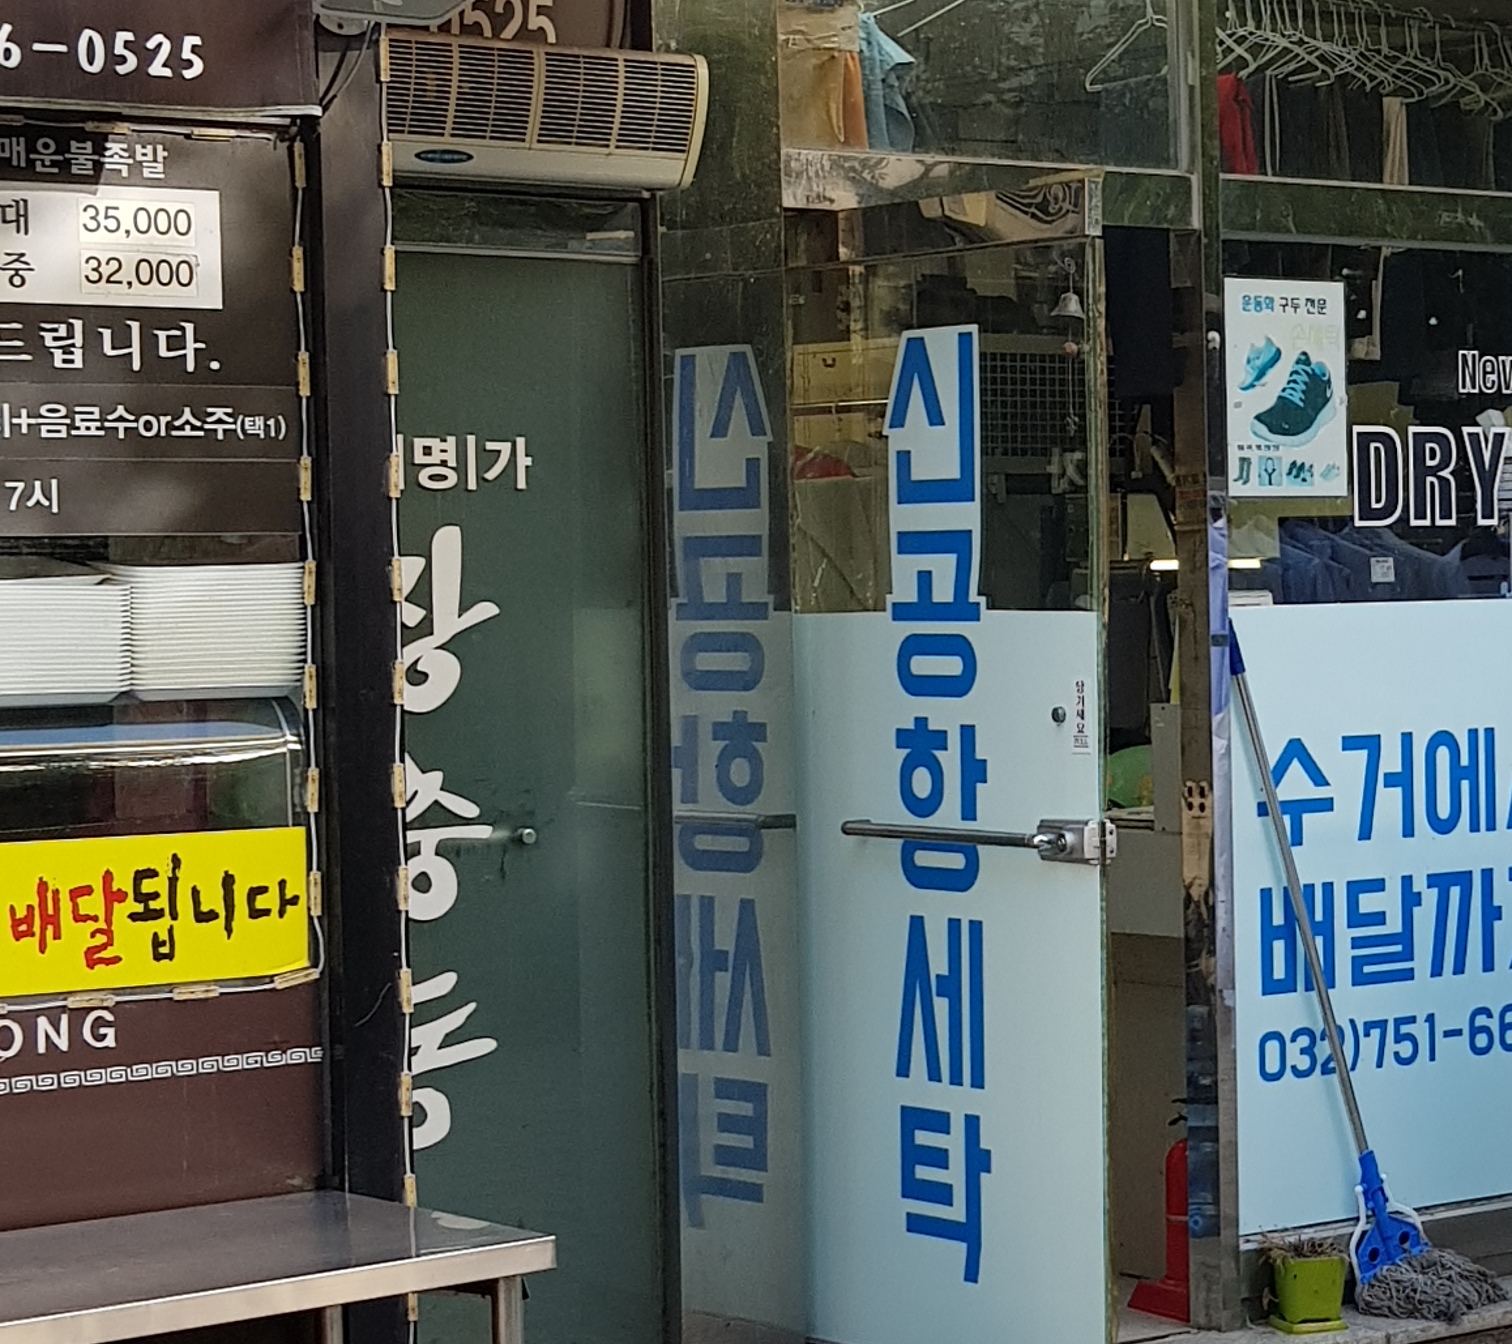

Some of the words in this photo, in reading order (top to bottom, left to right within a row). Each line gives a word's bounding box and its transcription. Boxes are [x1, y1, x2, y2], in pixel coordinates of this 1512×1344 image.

[0, 22, 205, 80] 6-0525
[0, 137, 168, 179] 매운불족발
[0, 198, 29, 236] 대
[81, 203, 192, 238] 35,000
[0, 252, 35, 288] 중
[83, 256, 194, 289] 32,000
[1279, 296, 1300, 314] 구두
[4, 478, 60, 514] 7시
[1351, 424, 1512, 527] DRY
[889, 334, 992, 1285] 신공항세탁
[9, 852, 300, 970] 배달됩니다
